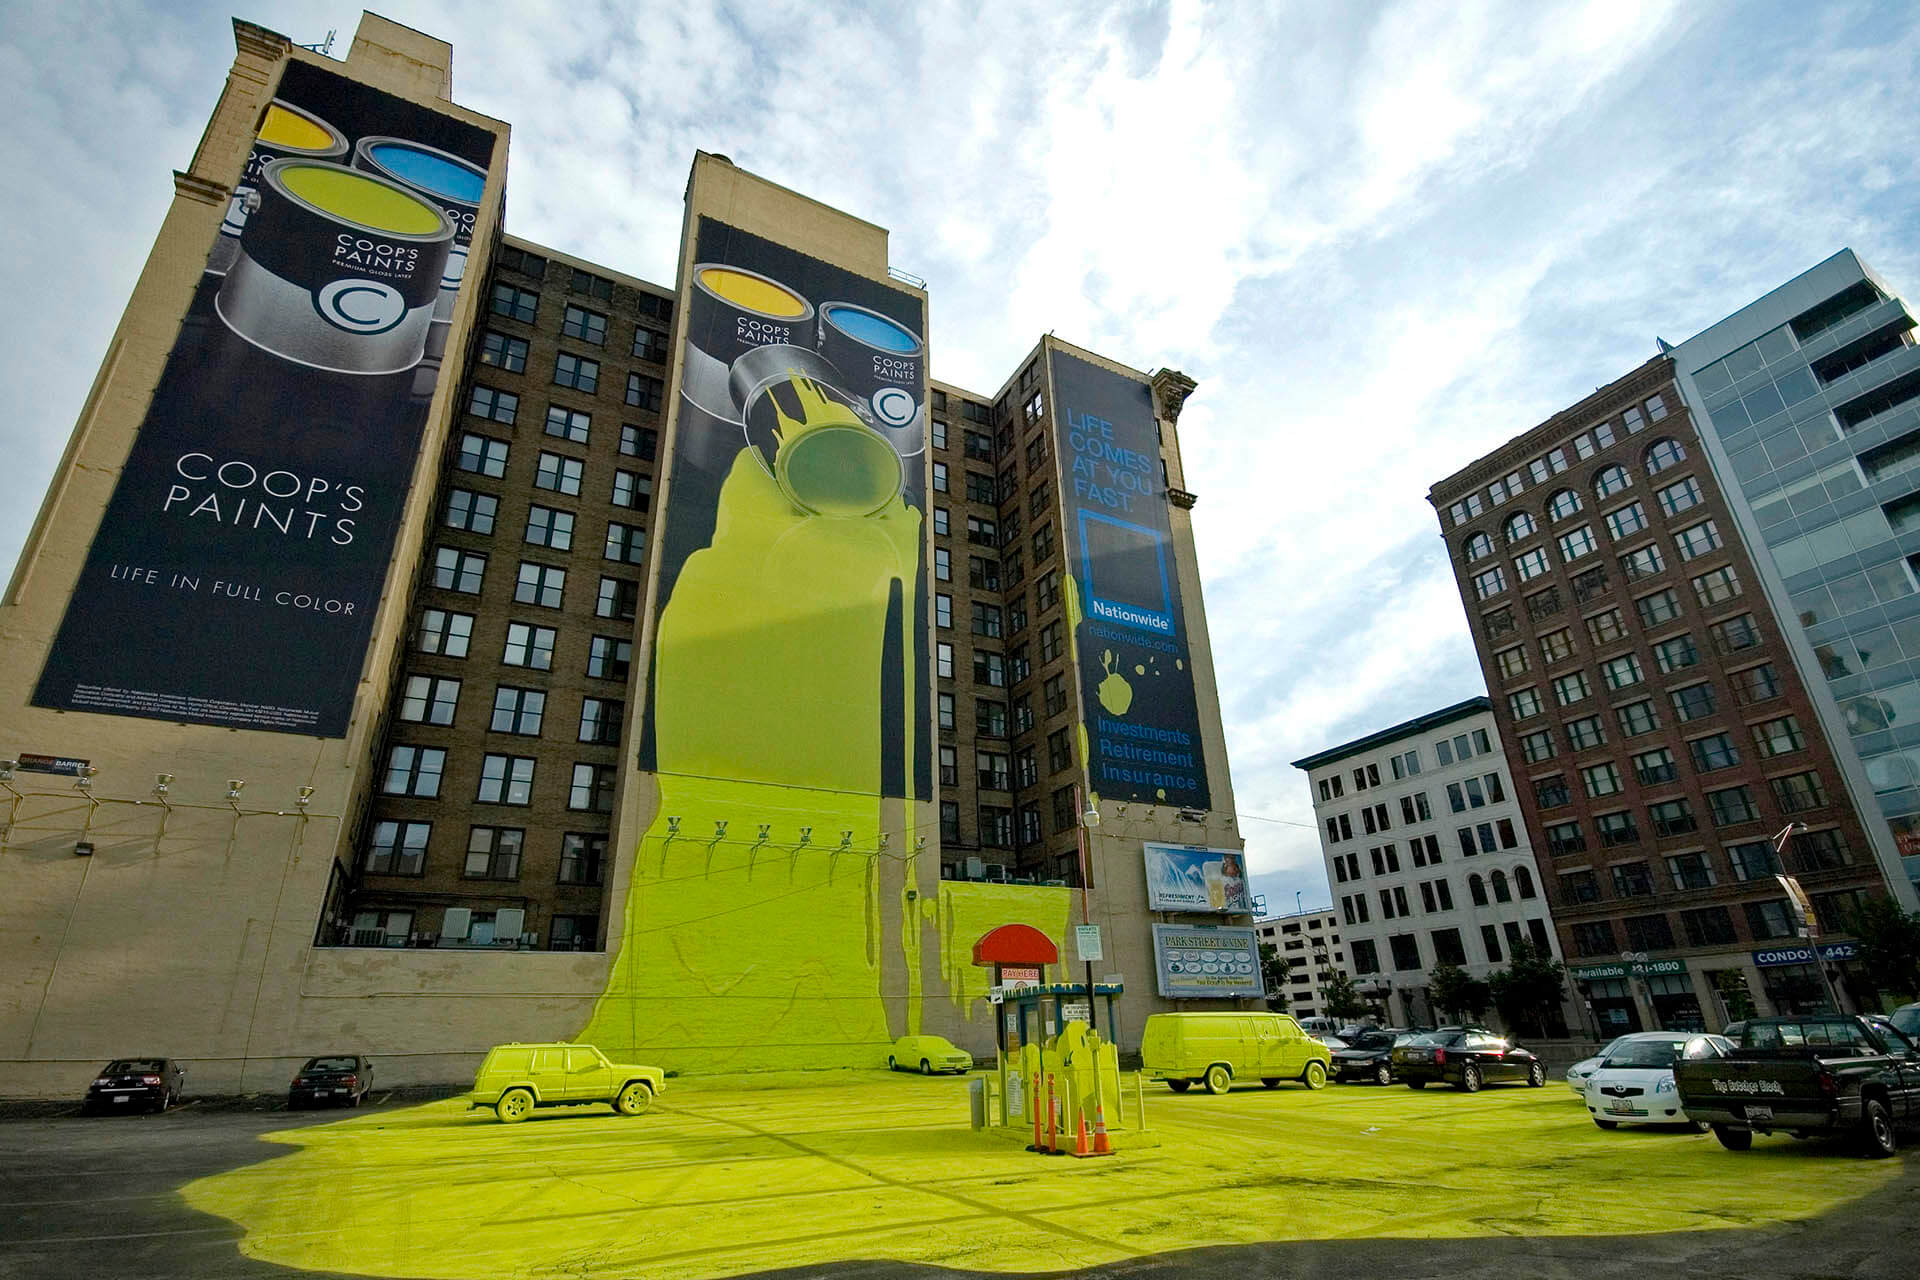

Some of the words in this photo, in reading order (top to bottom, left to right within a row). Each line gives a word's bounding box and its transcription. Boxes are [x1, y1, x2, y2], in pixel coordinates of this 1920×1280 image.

[334, 245, 416, 272] PAINTS
[337, 233, 419, 260] COOP'S
[332, 259, 367, 273] PREMIUM
[737, 316, 790, 337] COOP'S
[737, 326, 790, 346] PAINTS
[873, 364, 915, 380] PAINTS
[1066, 407, 1114, 441] LIFE
[1068, 431, 1151, 474] COMES
[176, 452, 365, 512] COOP'S
[1071, 455, 1099, 479] AT
[1106, 465, 1153, 497] YOU
[1074, 477, 1134, 513] FAST.
[163, 484, 356, 545] PAINTS
[111, 563, 159, 585] LIFE
[170, 574, 200, 591] IN
[212, 581, 261, 601] FULL
[275, 591, 355, 616] COLOR
[1093, 600, 1170, 630] Nationwide
[1088, 622, 1179, 654] nationwide.com
[1097, 717, 1192, 746] Investments
[1100, 738, 1194, 768] Retirement
[1102, 762, 1198, 790] Insurance
[1002, 969, 1016, 977] PAY
[1018, 970, 1038, 978] HERE
[1578, 966, 1625, 979] Available
